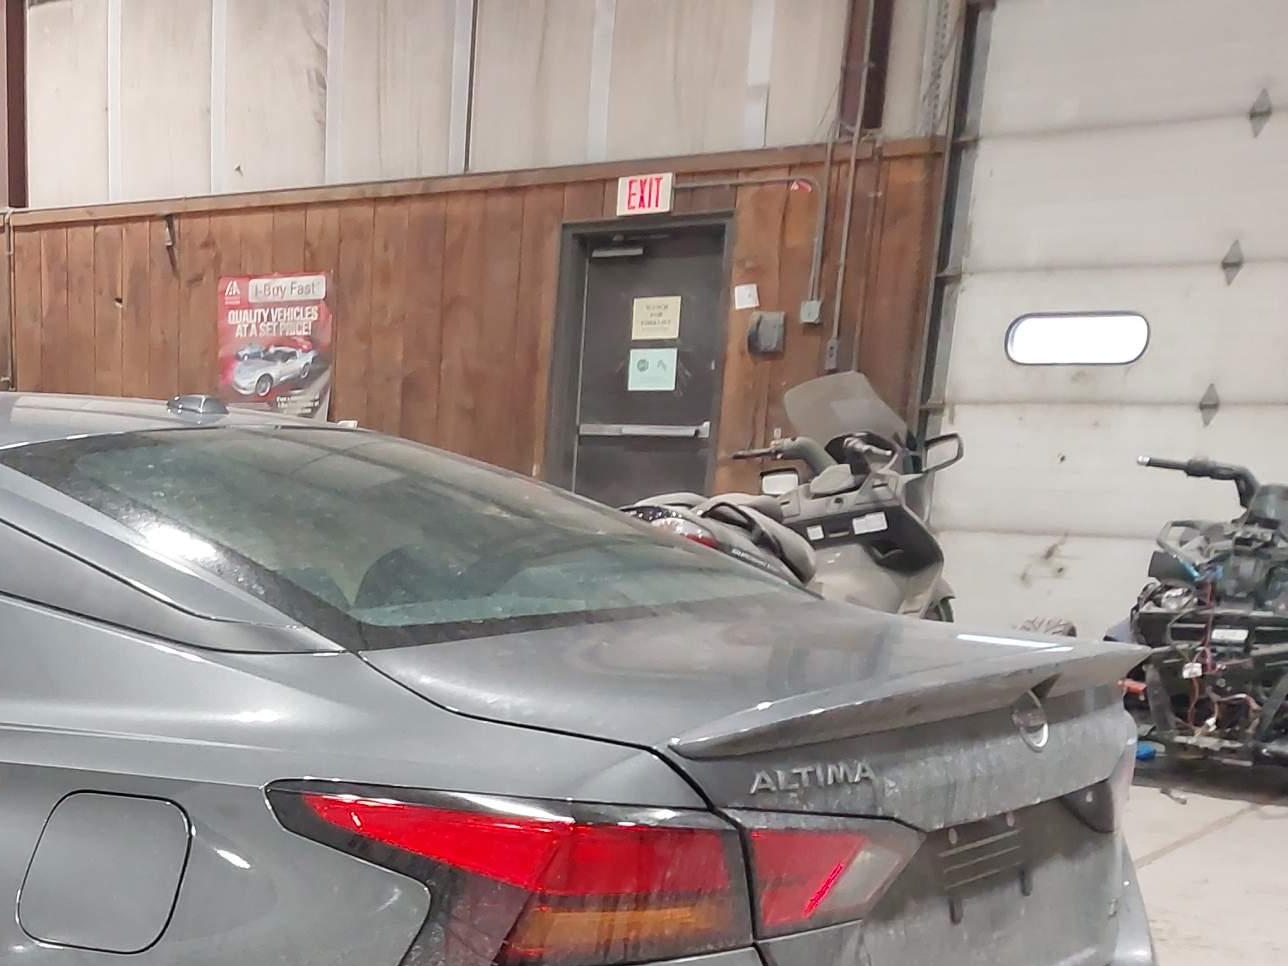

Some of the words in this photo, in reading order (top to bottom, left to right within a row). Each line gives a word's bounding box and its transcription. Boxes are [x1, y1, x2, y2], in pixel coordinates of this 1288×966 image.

[626, 176, 664, 210] EXIT
[254, 283, 287, 298] I-Buy
[290, 281, 316, 294] Fast
[227, 308, 271, 325] QUALITY
[271, 305, 318, 321] VEHICLES
[235, 323, 250, 337] AT
[250, 323, 258, 337] A
[259, 322, 280, 337] SET
[280, 320, 312, 336] PRICE!
[748, 760, 876, 796] ALTIMA
